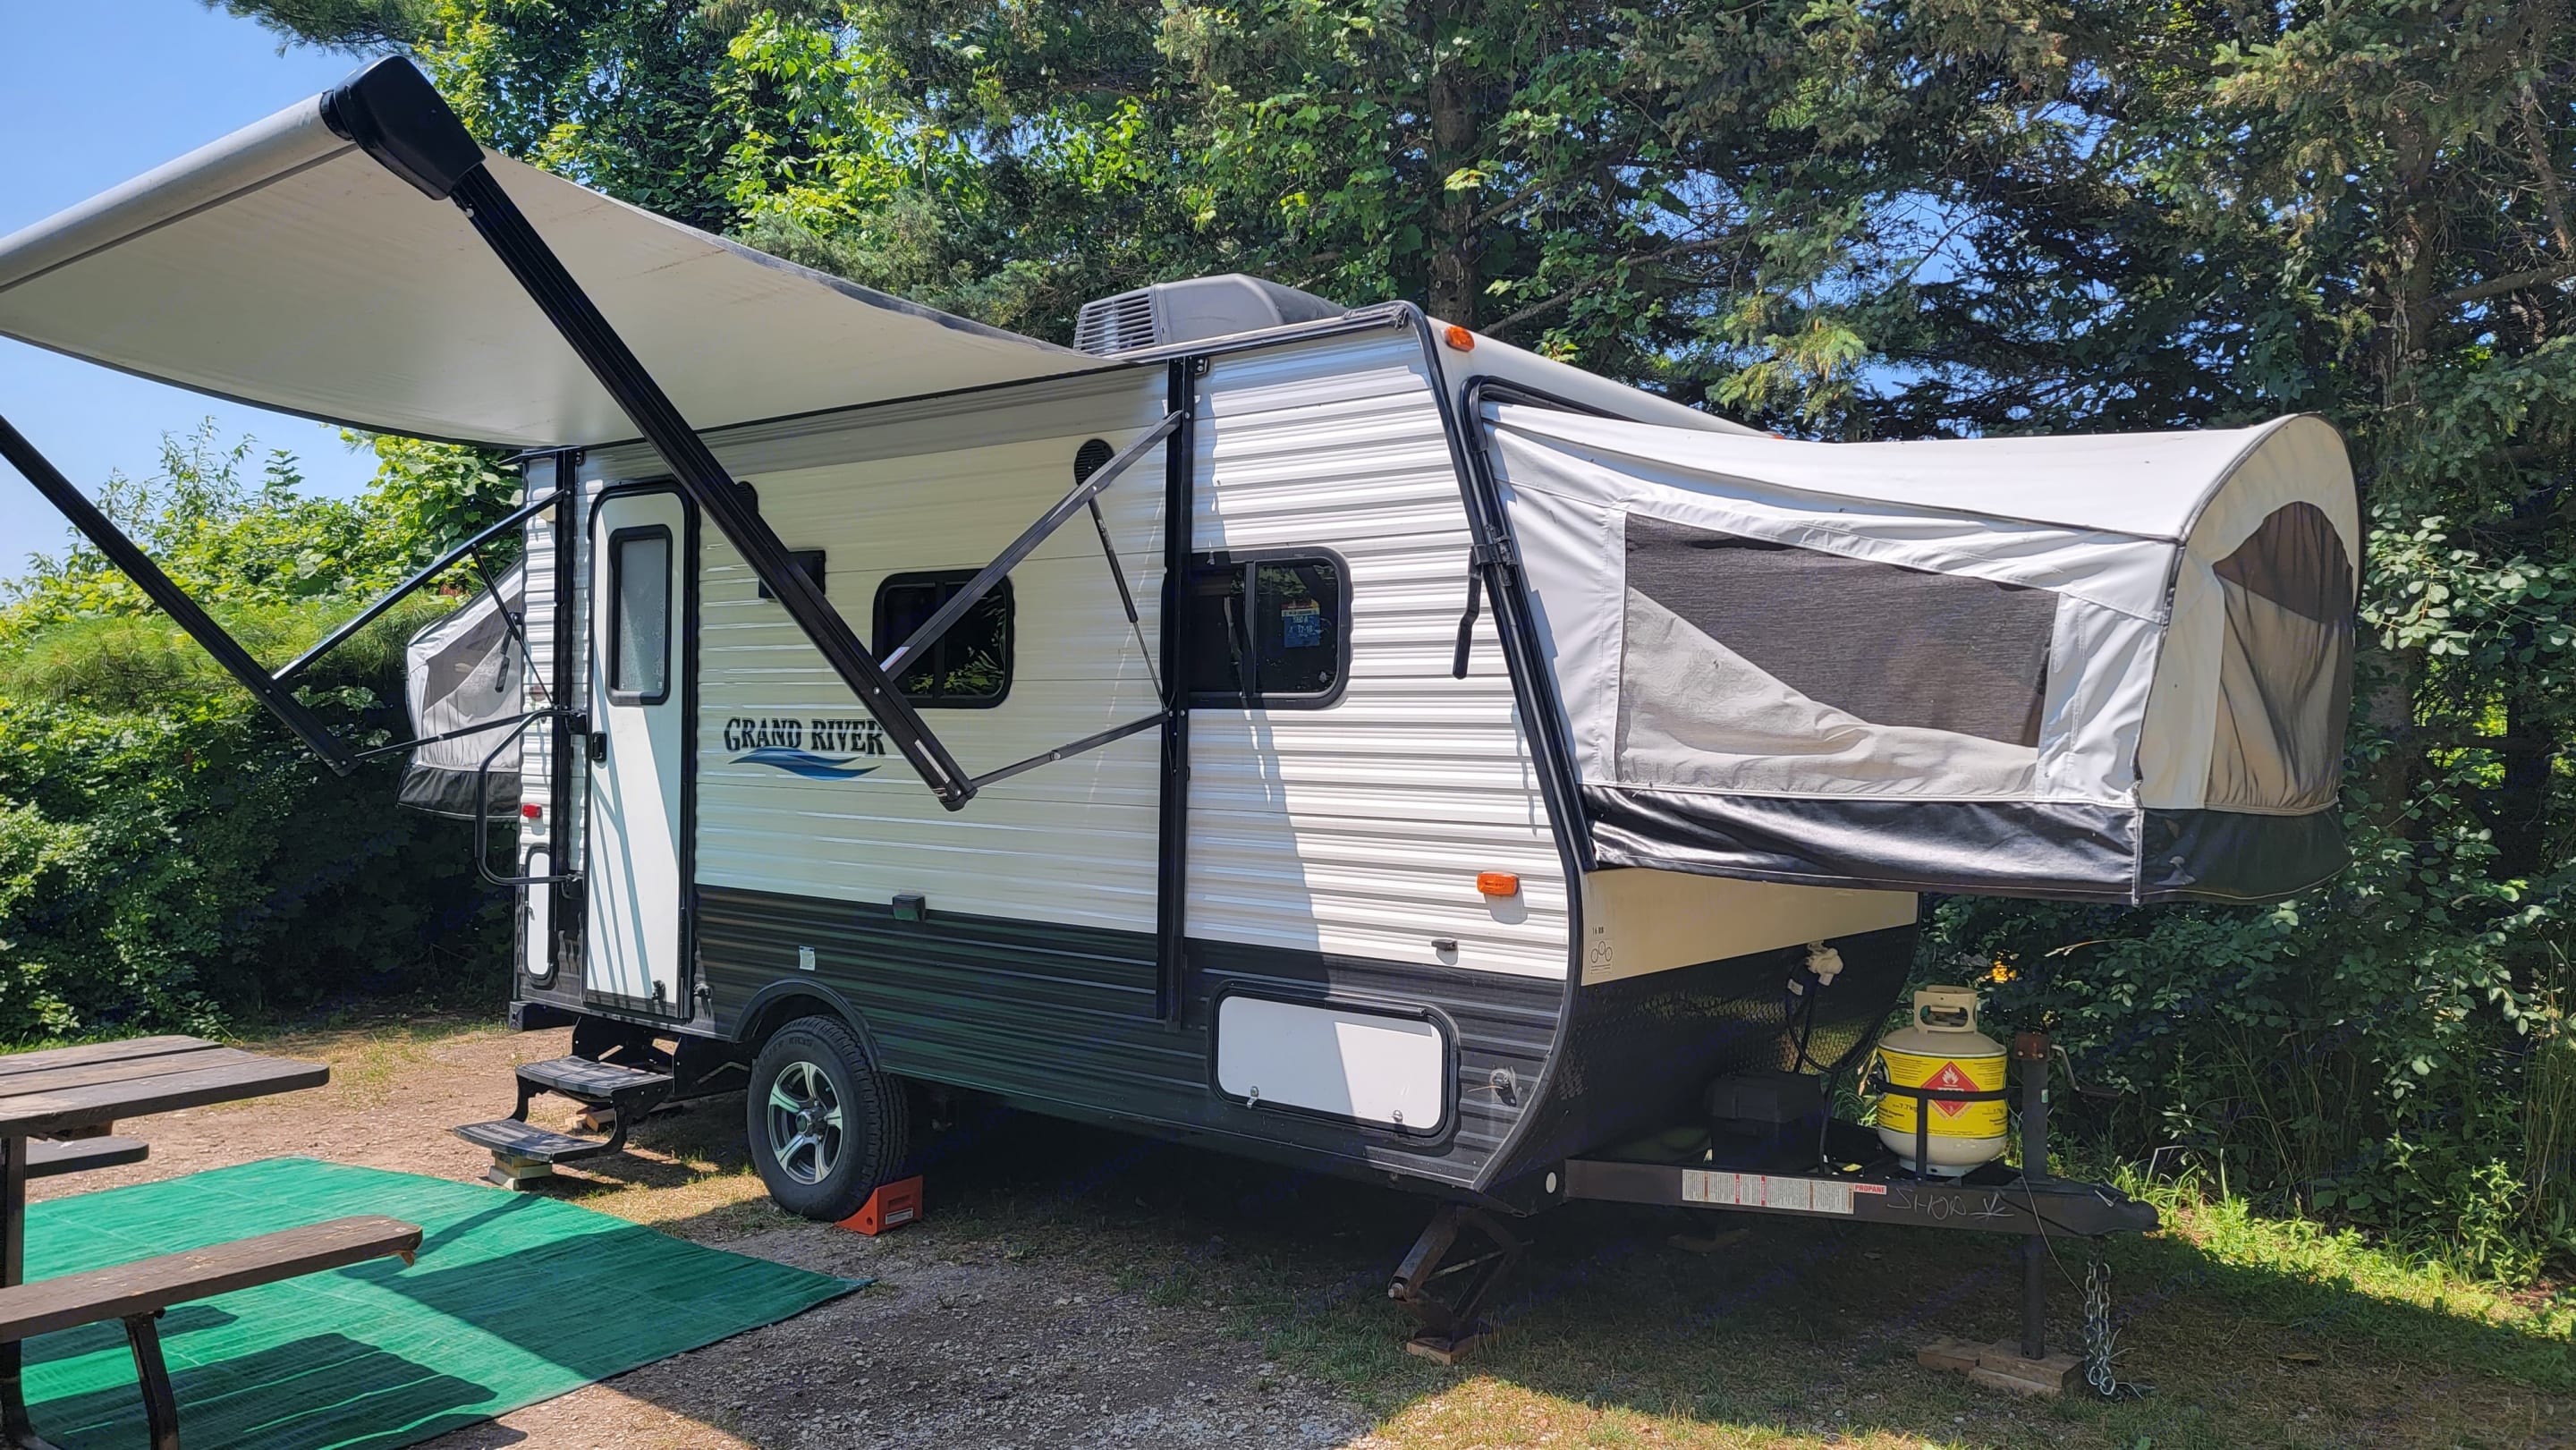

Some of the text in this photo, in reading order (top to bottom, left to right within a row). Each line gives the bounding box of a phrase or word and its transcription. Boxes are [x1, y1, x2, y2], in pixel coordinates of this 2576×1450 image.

[724, 717, 886, 756] GRAND RIVER
[1854, 1184, 1885, 1193] PROPANE
